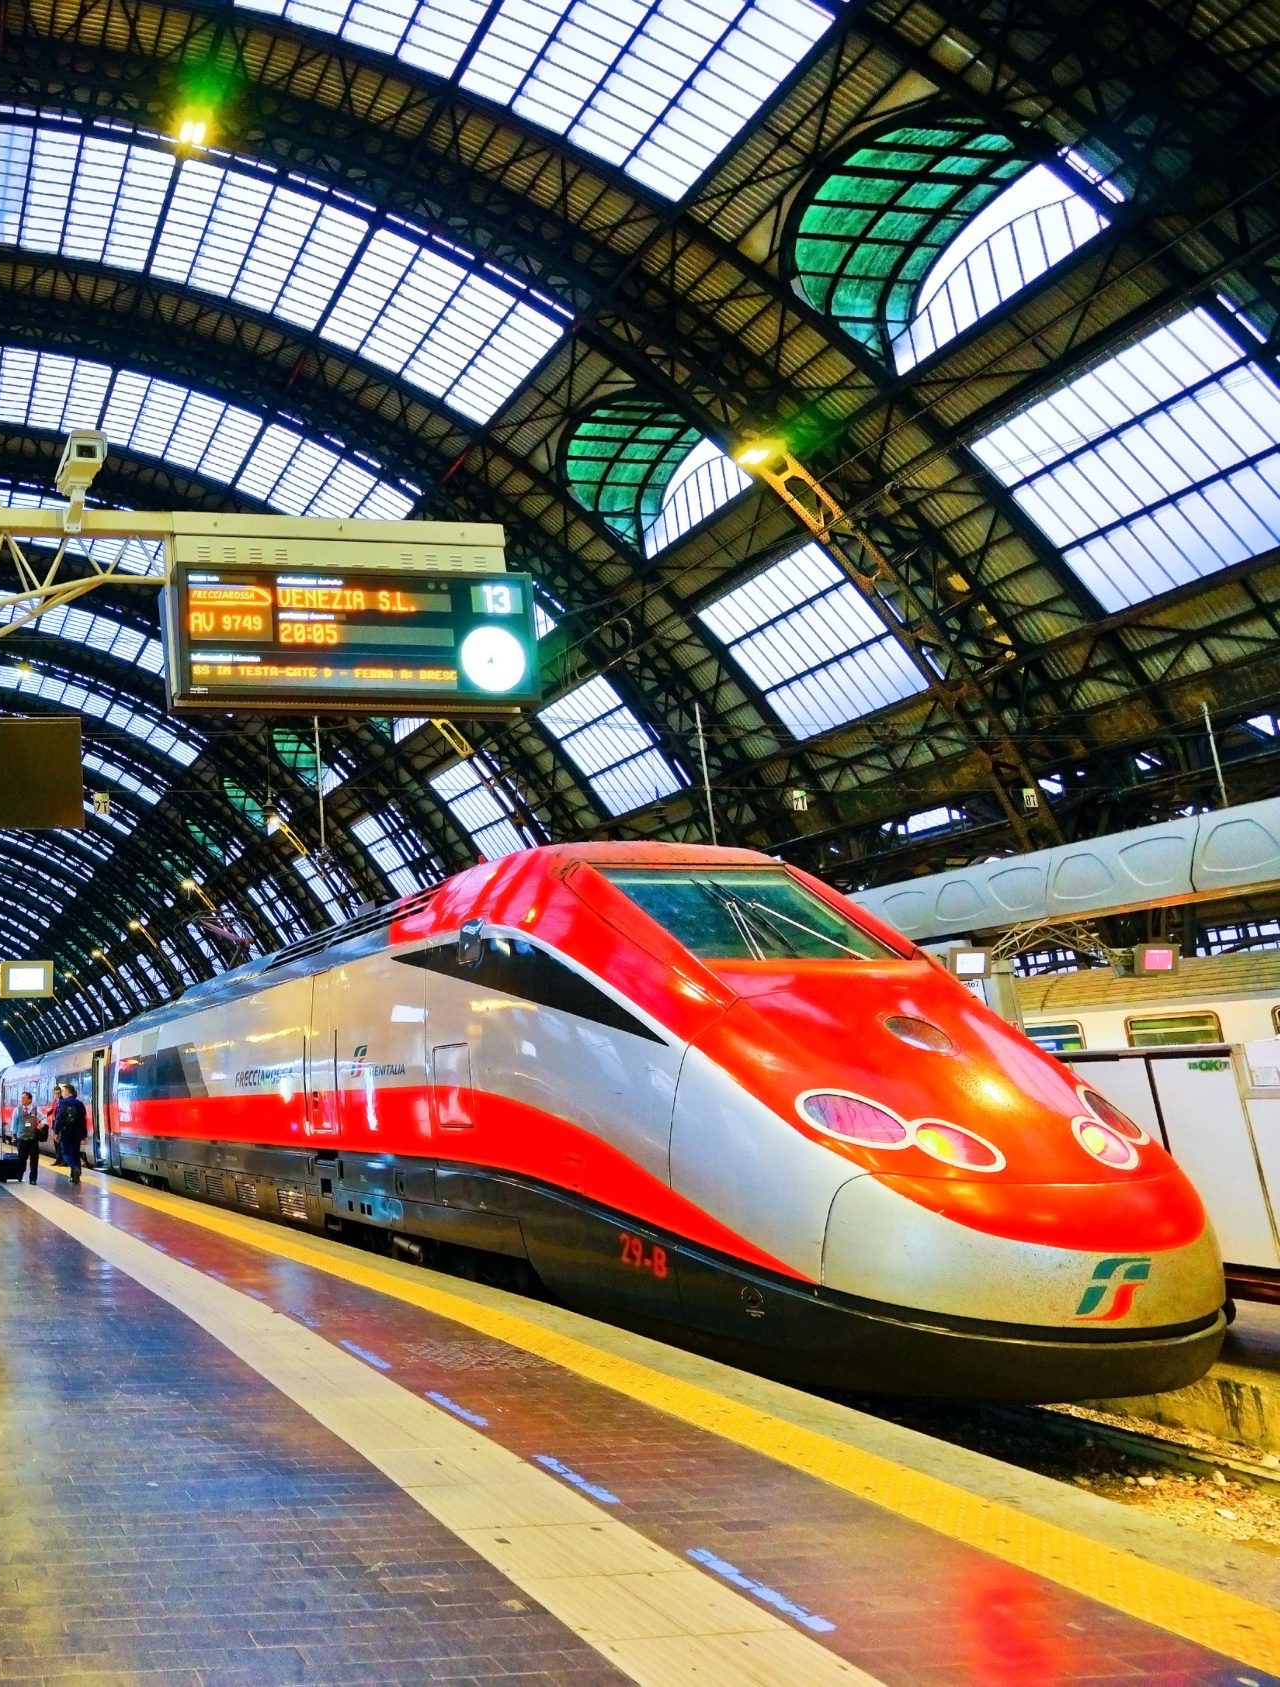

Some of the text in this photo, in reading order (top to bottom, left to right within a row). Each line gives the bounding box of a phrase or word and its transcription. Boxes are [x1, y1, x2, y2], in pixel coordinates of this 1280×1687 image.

[192, 589, 255, 600] FRECCIAROSSA
[278, 588, 416, 611] VENEZIA S.L.
[483, 585, 511, 613] 13
[190, 612, 214, 632] AV
[222, 615, 262, 631] 9749
[280, 623, 338, 643] 20:05
[192, 665, 210, 675] SS
[239, 666, 317, 677] TESTA-GATE
[324, 668, 333, 678] D
[354, 668, 394, 679] FERMA
